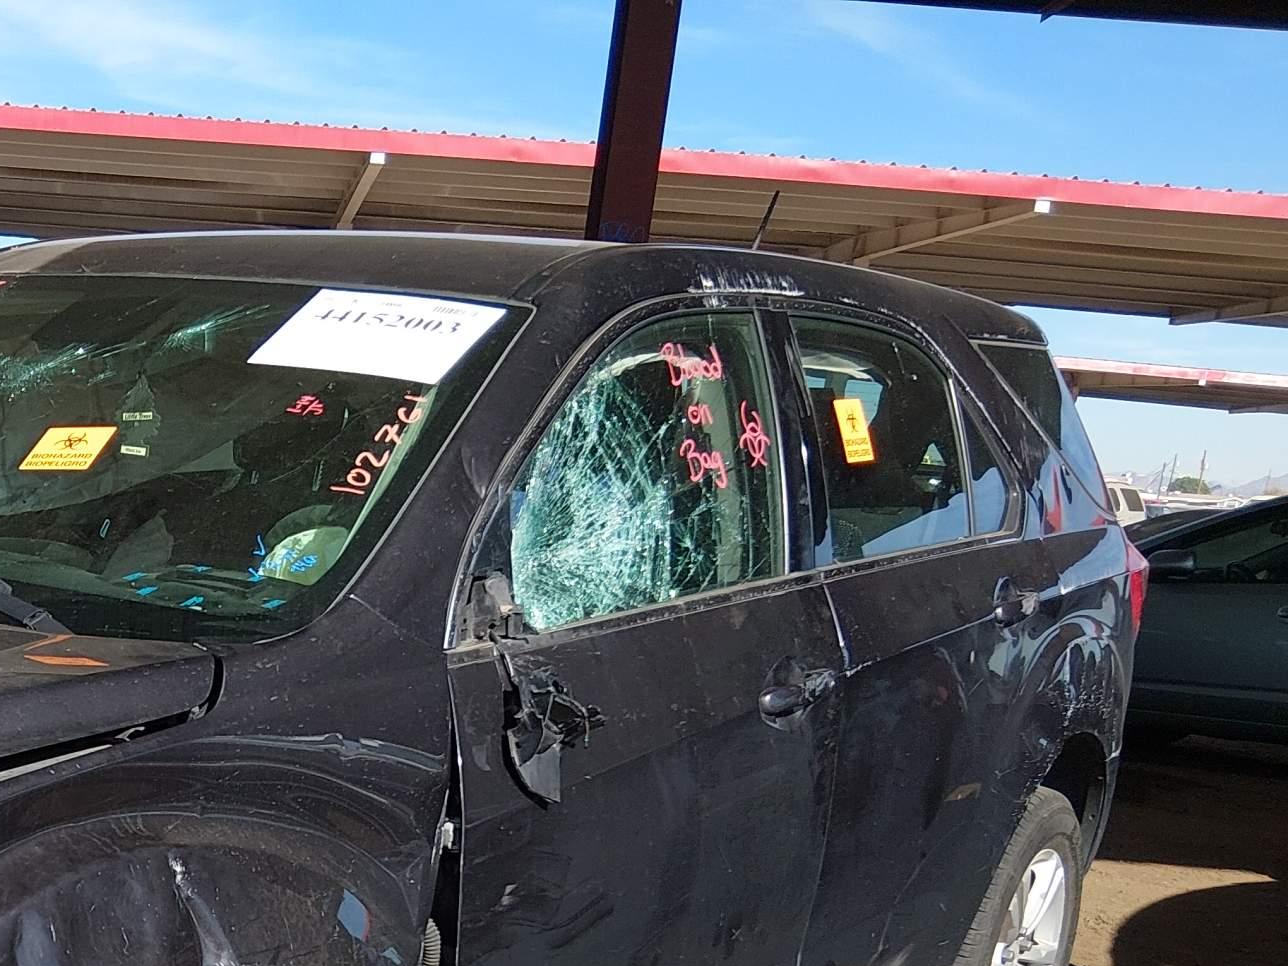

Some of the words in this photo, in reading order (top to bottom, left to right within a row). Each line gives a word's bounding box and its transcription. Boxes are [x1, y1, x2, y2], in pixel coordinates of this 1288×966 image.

[313, 308, 462, 334] 44152003
[659, 342, 725, 387] Blood
[329, 393, 429, 495] 102761
